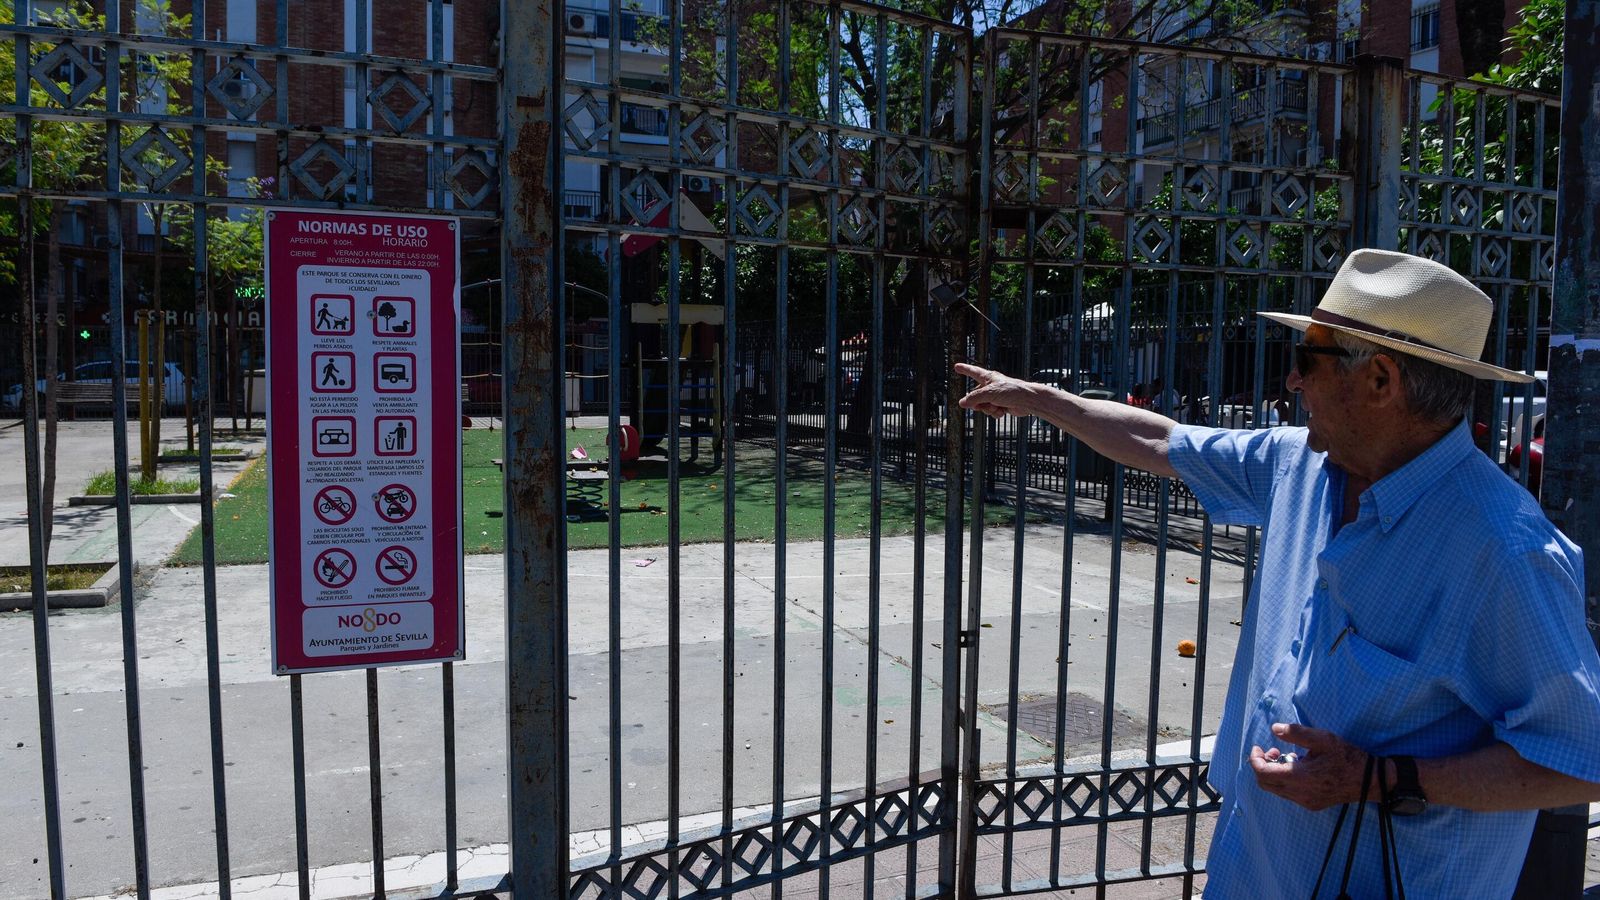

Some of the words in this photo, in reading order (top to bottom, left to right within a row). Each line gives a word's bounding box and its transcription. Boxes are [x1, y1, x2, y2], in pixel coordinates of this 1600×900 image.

[298, 220, 367, 236] NORMAS
[372, 224, 392, 236] DE
[397, 225, 428, 238] USO
[290, 237, 328, 246] APERTURA
[382, 238, 428, 248] HORARIO
[327, 257, 360, 265] INVIERNO
[309, 636, 378, 647] AYUNTAMIENTO
[396, 633, 428, 642] SEVILLA
